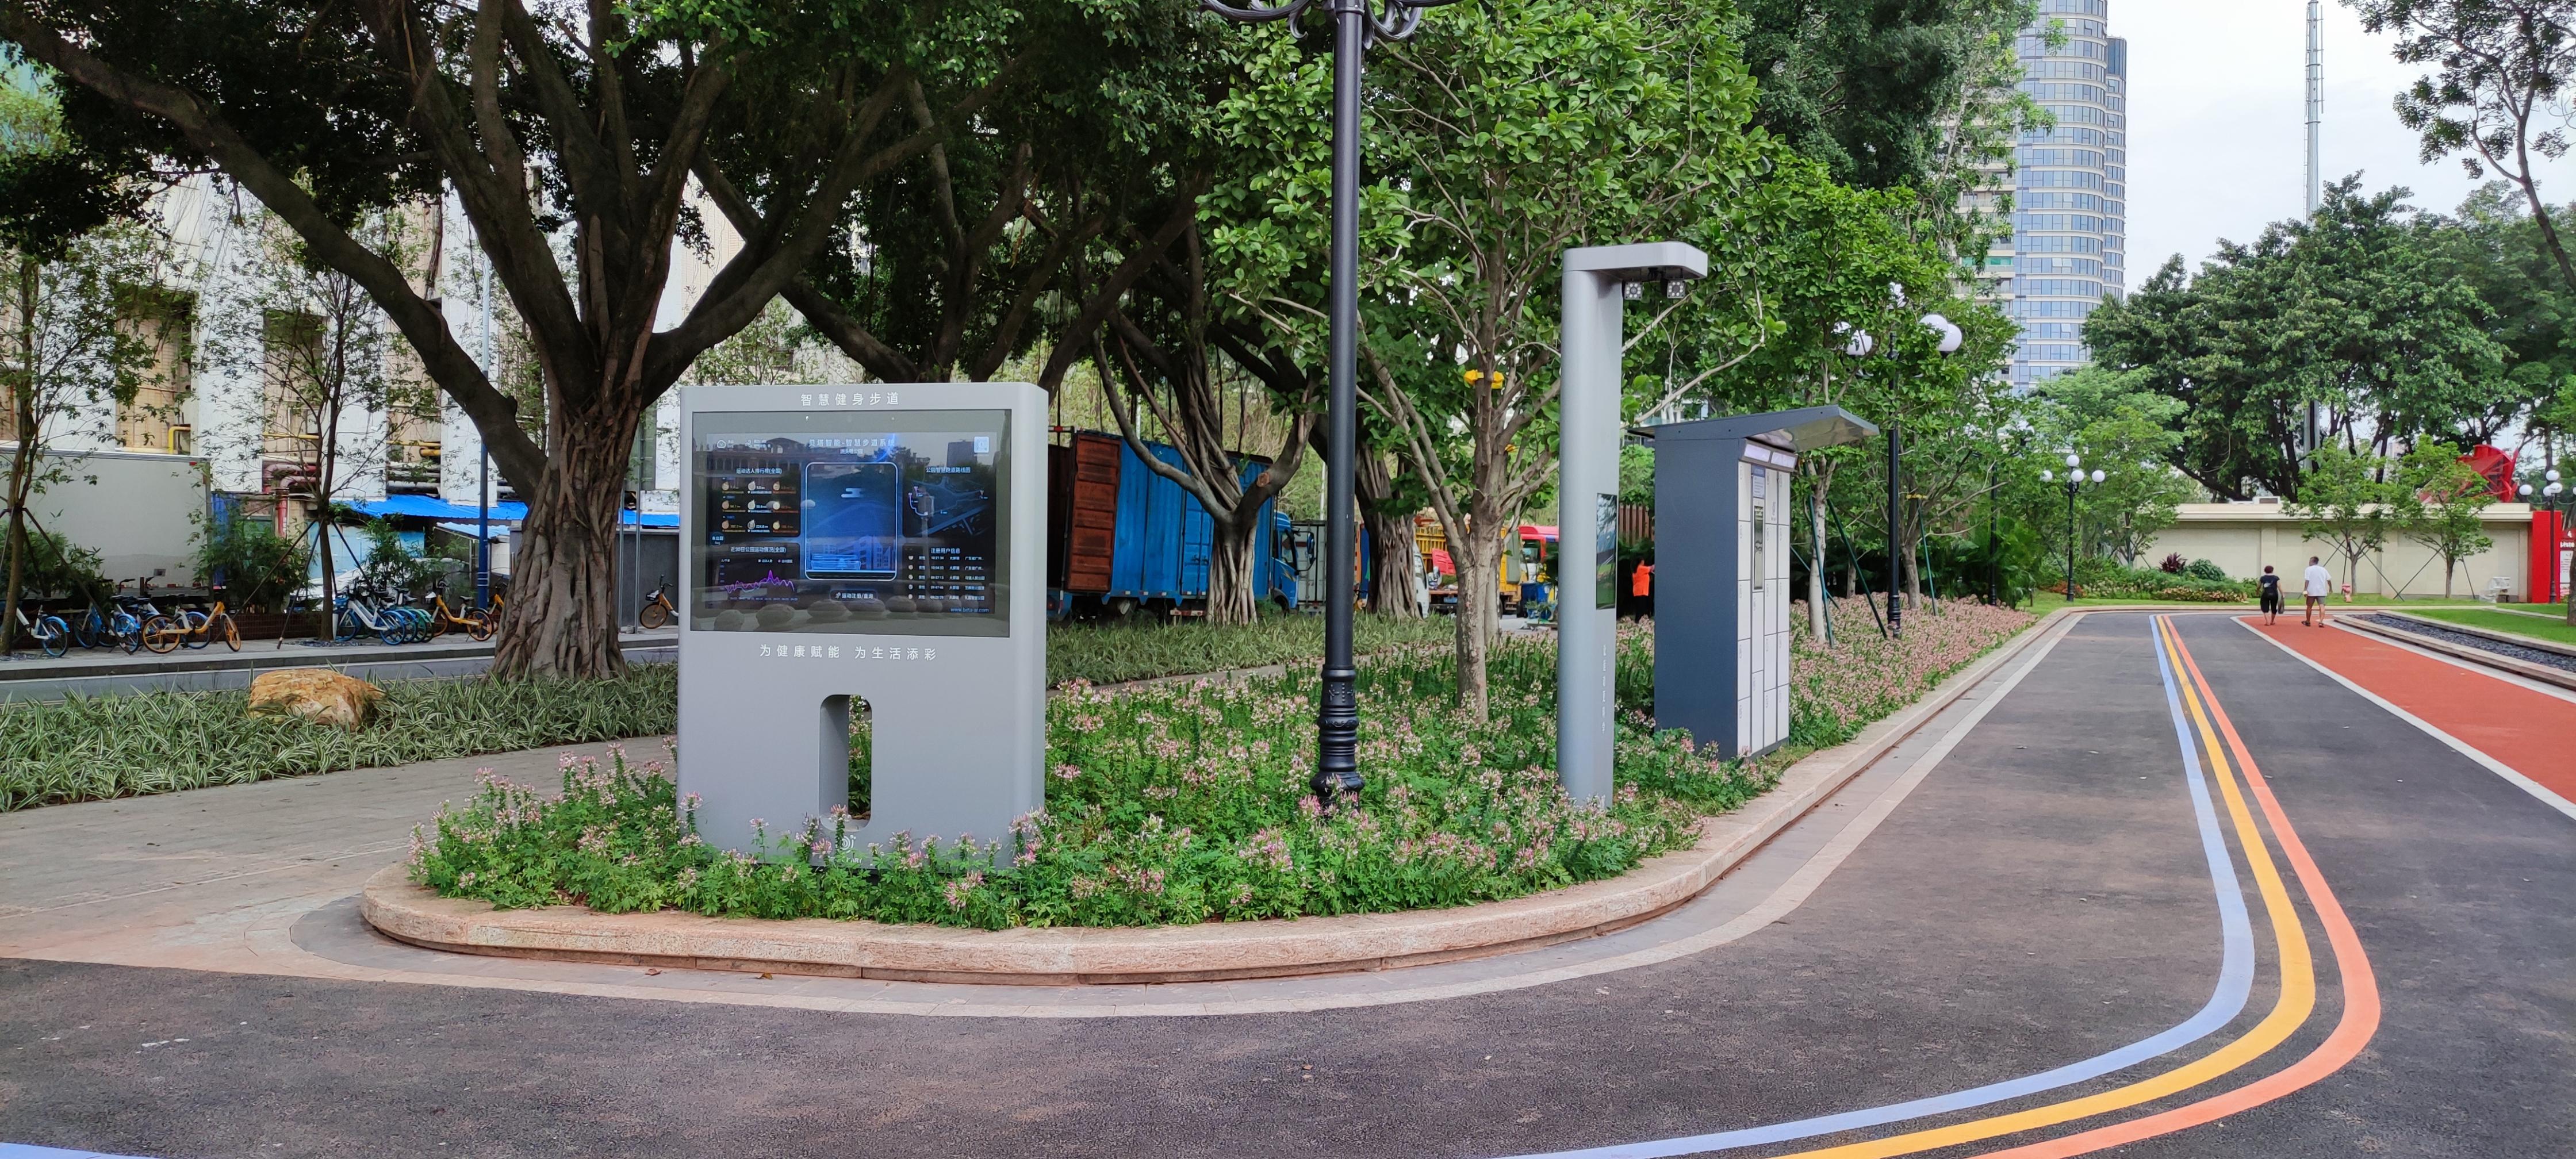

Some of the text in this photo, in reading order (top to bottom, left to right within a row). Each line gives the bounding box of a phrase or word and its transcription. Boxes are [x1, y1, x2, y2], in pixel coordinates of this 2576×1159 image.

[800, 391, 899, 406] 智慧健身步道
[760, 644, 936, 661] 为健康赋能 为生活添彩
